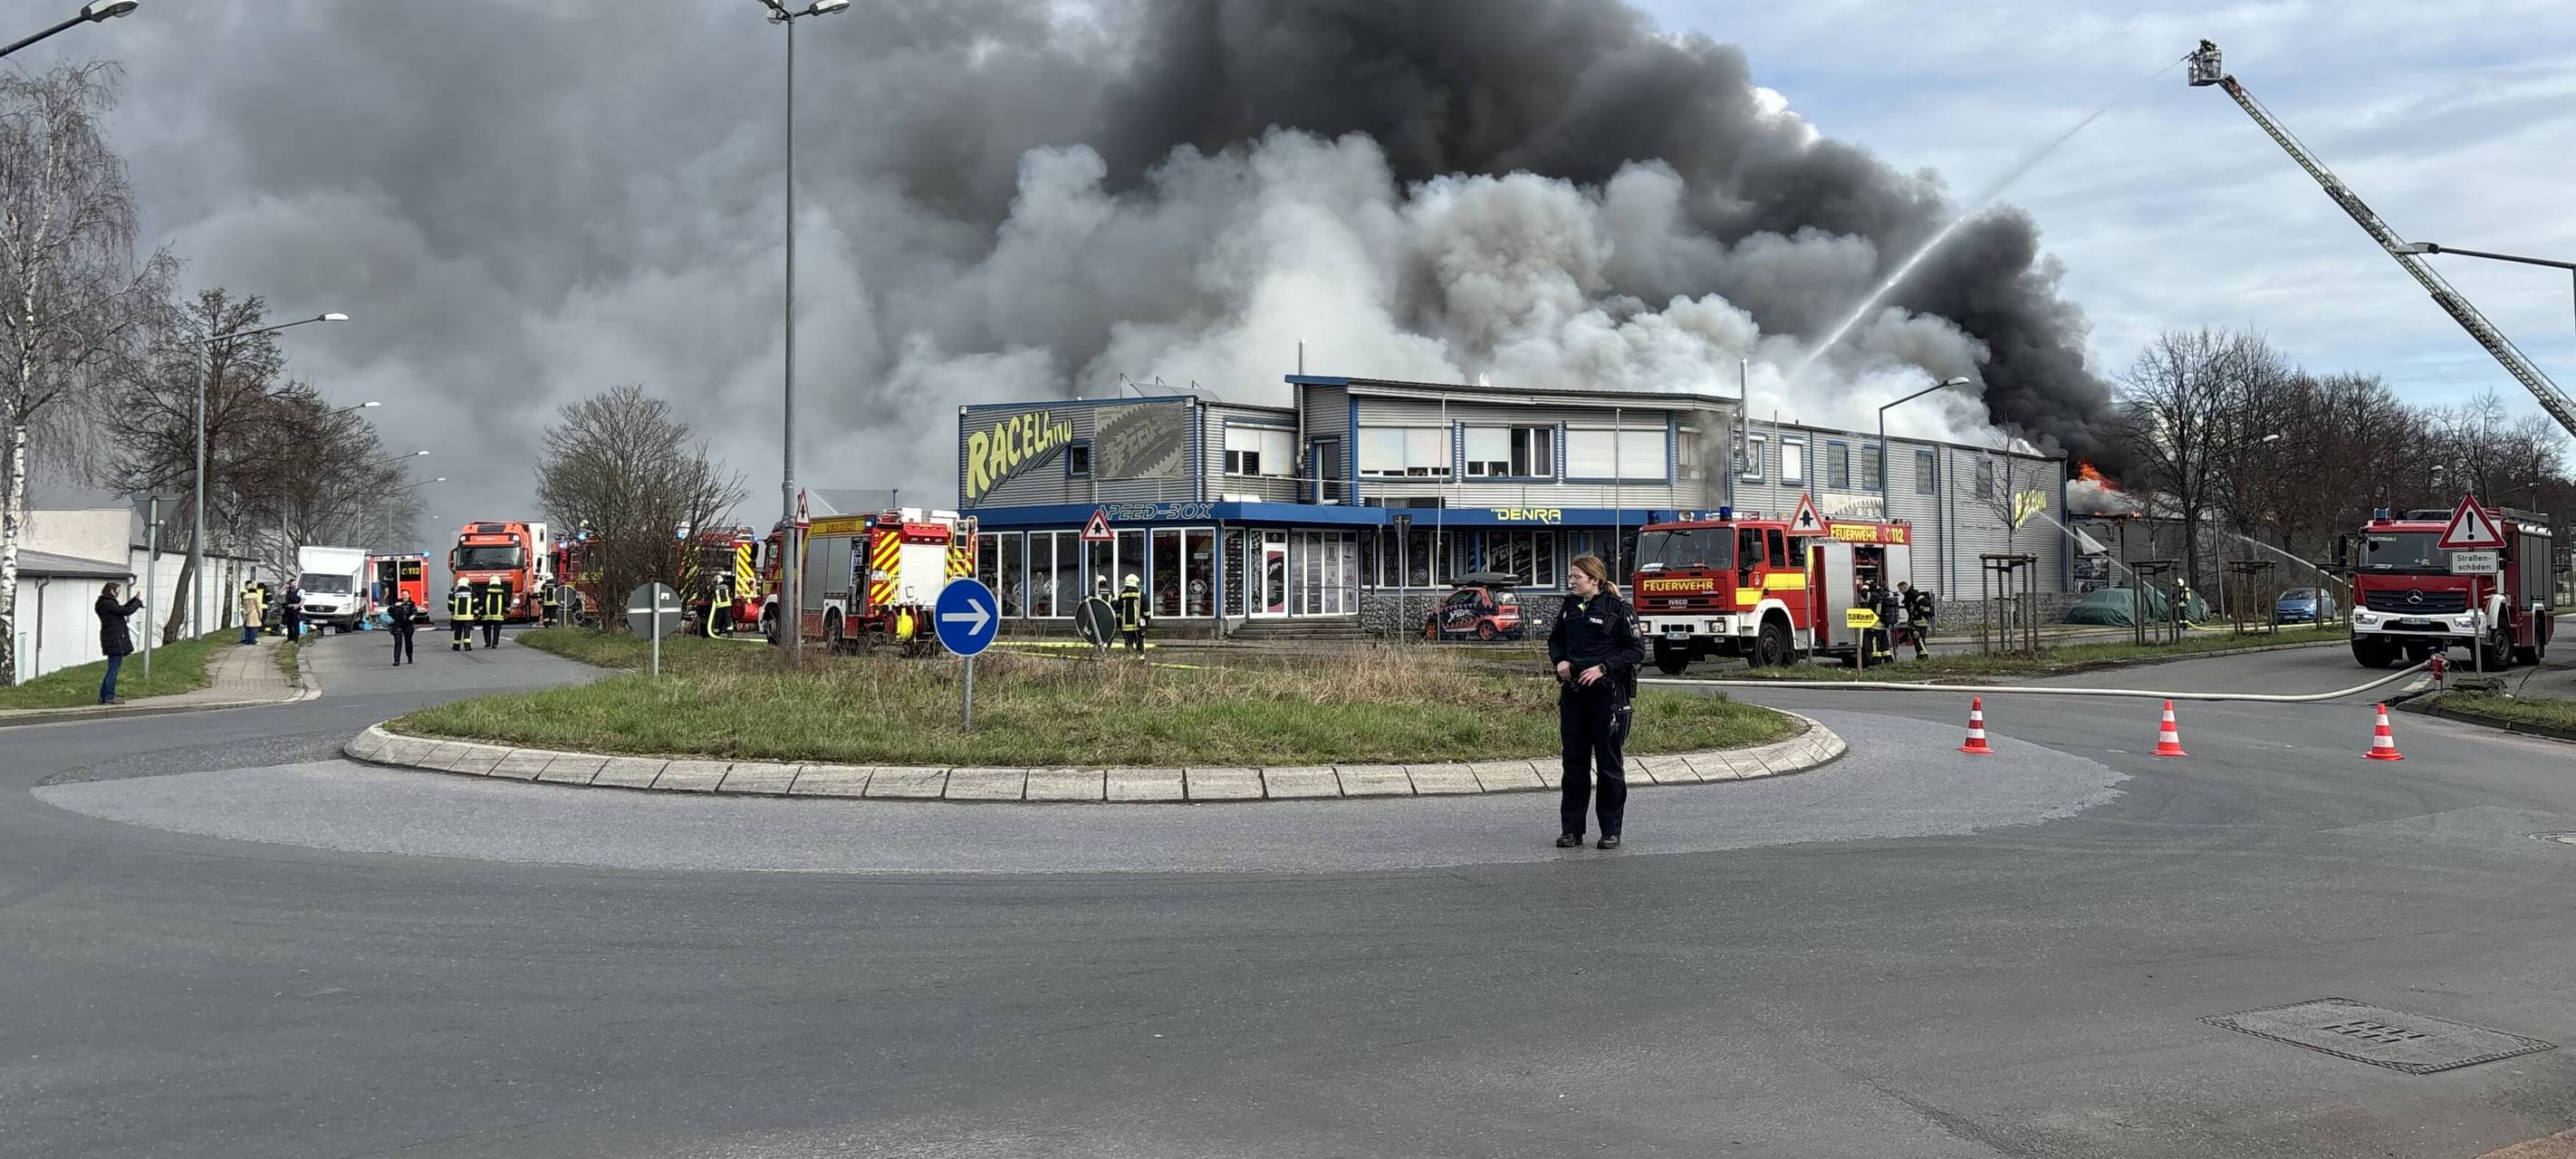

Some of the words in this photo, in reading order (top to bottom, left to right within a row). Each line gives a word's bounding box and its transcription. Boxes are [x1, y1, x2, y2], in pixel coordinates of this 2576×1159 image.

[1491, 509, 1562, 524] DENRA
[1831, 525, 1877, 542] FEUERWEHR
[1892, 528, 1904, 542] 112
[2456, 554, 2493, 562] Straßen-
[1643, 579, 1714, 590] FEUERWEHR
